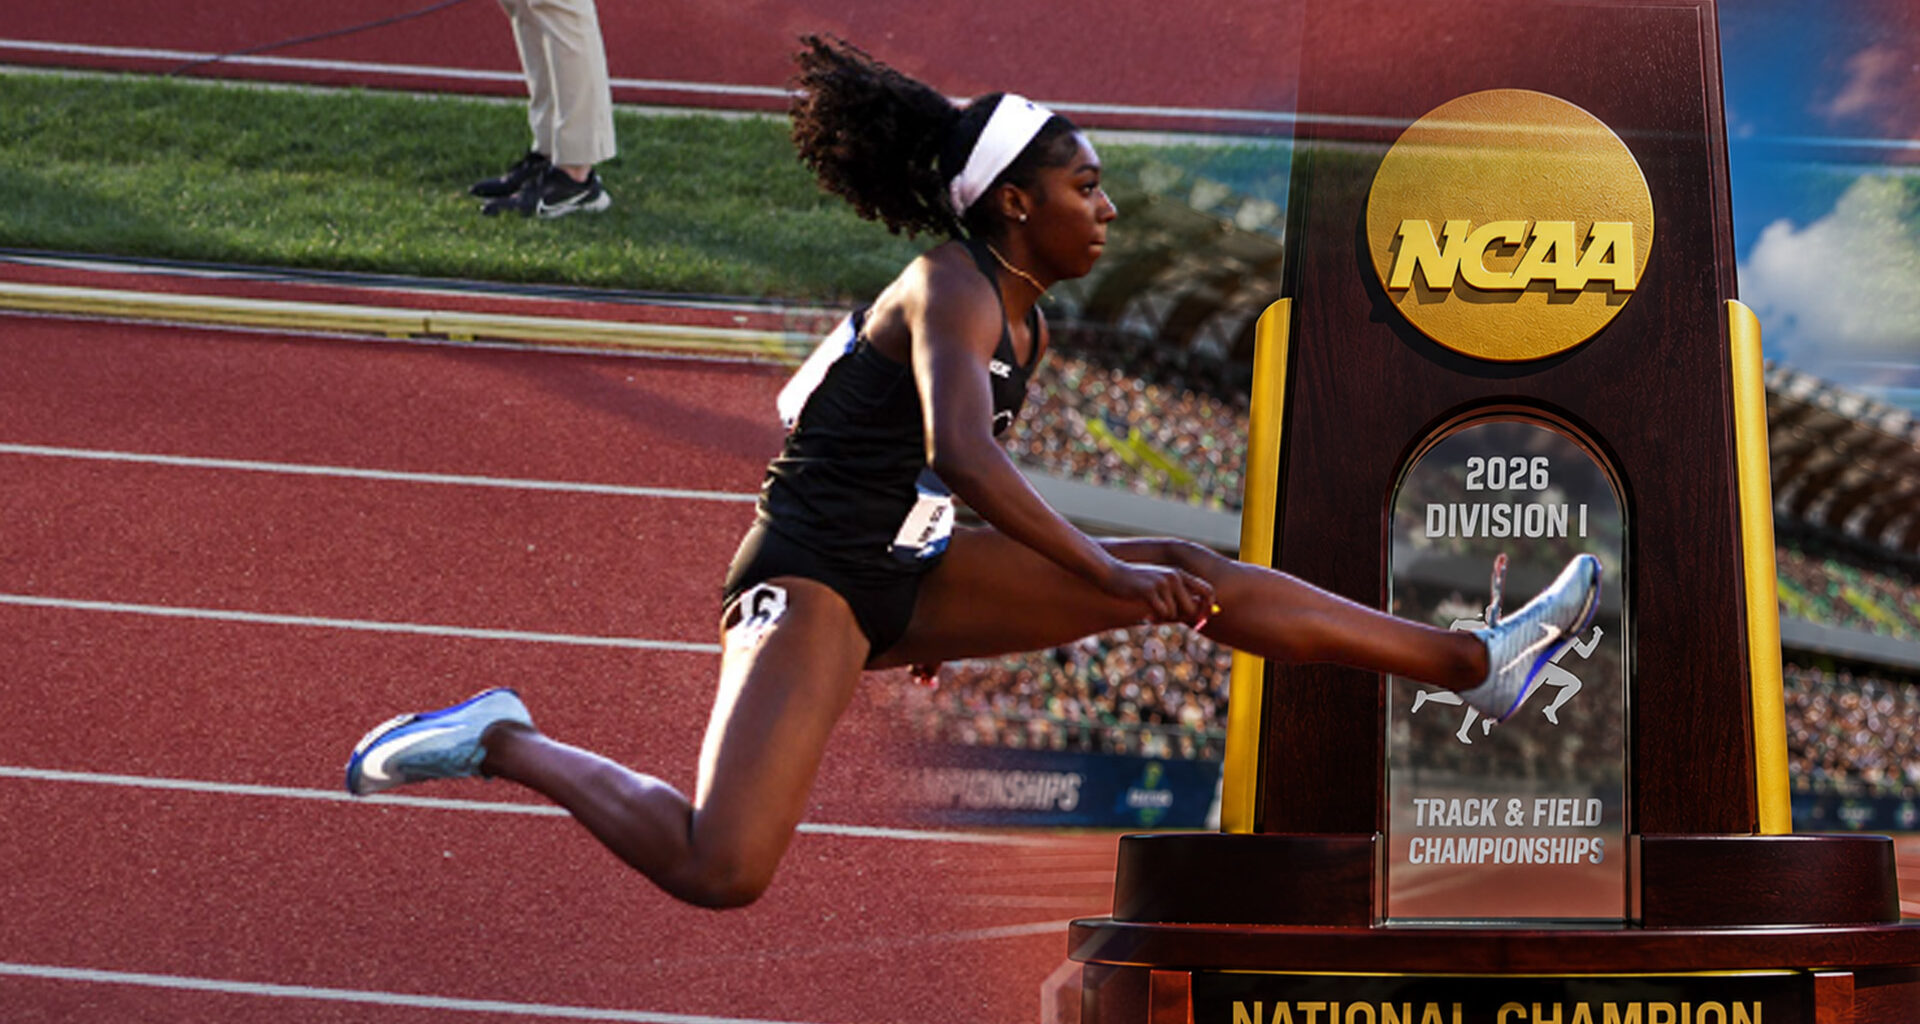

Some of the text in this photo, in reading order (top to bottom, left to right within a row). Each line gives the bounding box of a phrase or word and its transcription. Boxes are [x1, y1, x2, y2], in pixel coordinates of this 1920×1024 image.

[1389, 219, 1636, 291] NCAA
[1466, 456, 1549, 490] 2026
[1426, 503, 1587, 537] DIVISION I
[1413, 798, 1602, 826] TRACK & FIELD
[1409, 837, 1605, 864] CHAMPIONSHIPS
